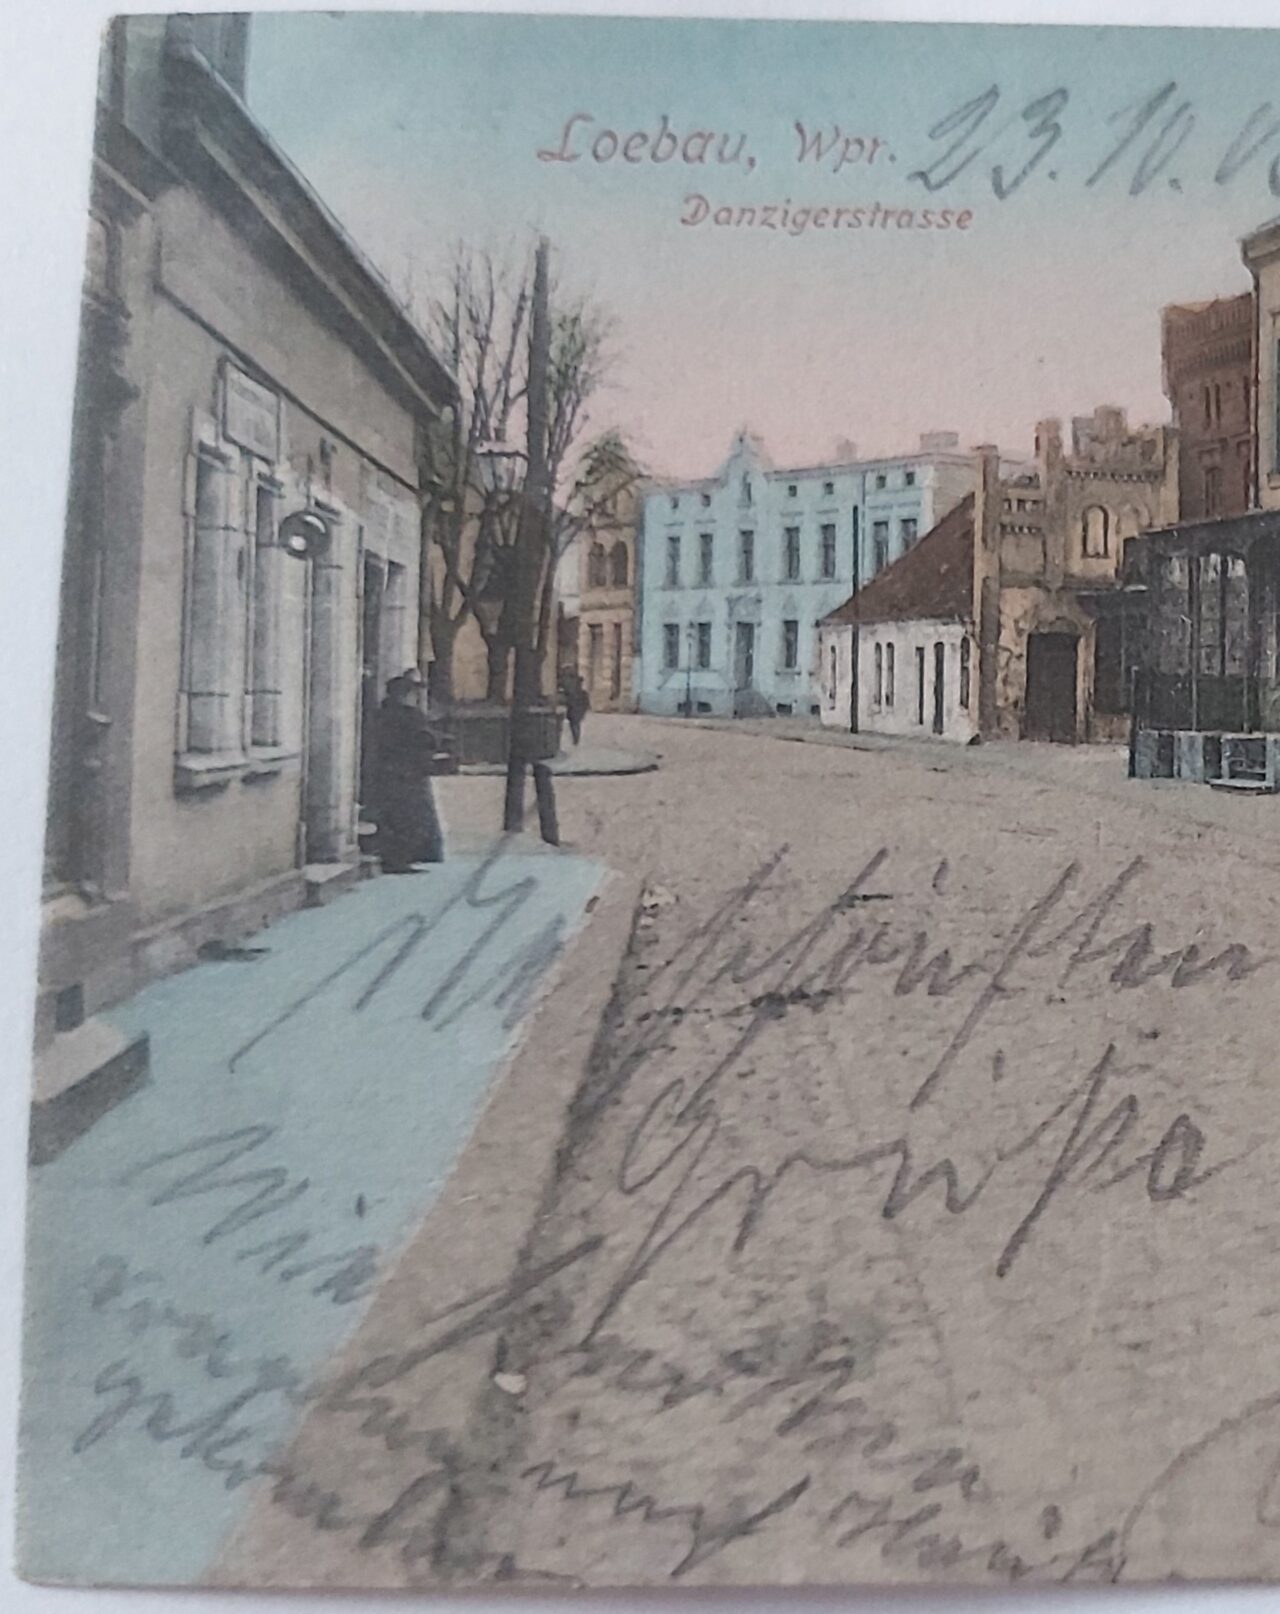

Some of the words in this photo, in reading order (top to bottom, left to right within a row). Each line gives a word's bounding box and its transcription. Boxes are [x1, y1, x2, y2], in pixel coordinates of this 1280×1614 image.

[536, 112, 757, 171] Loebau,
[795, 118, 897, 173] Wpr.
[680, 193, 974, 236] Danzigerstrasse
